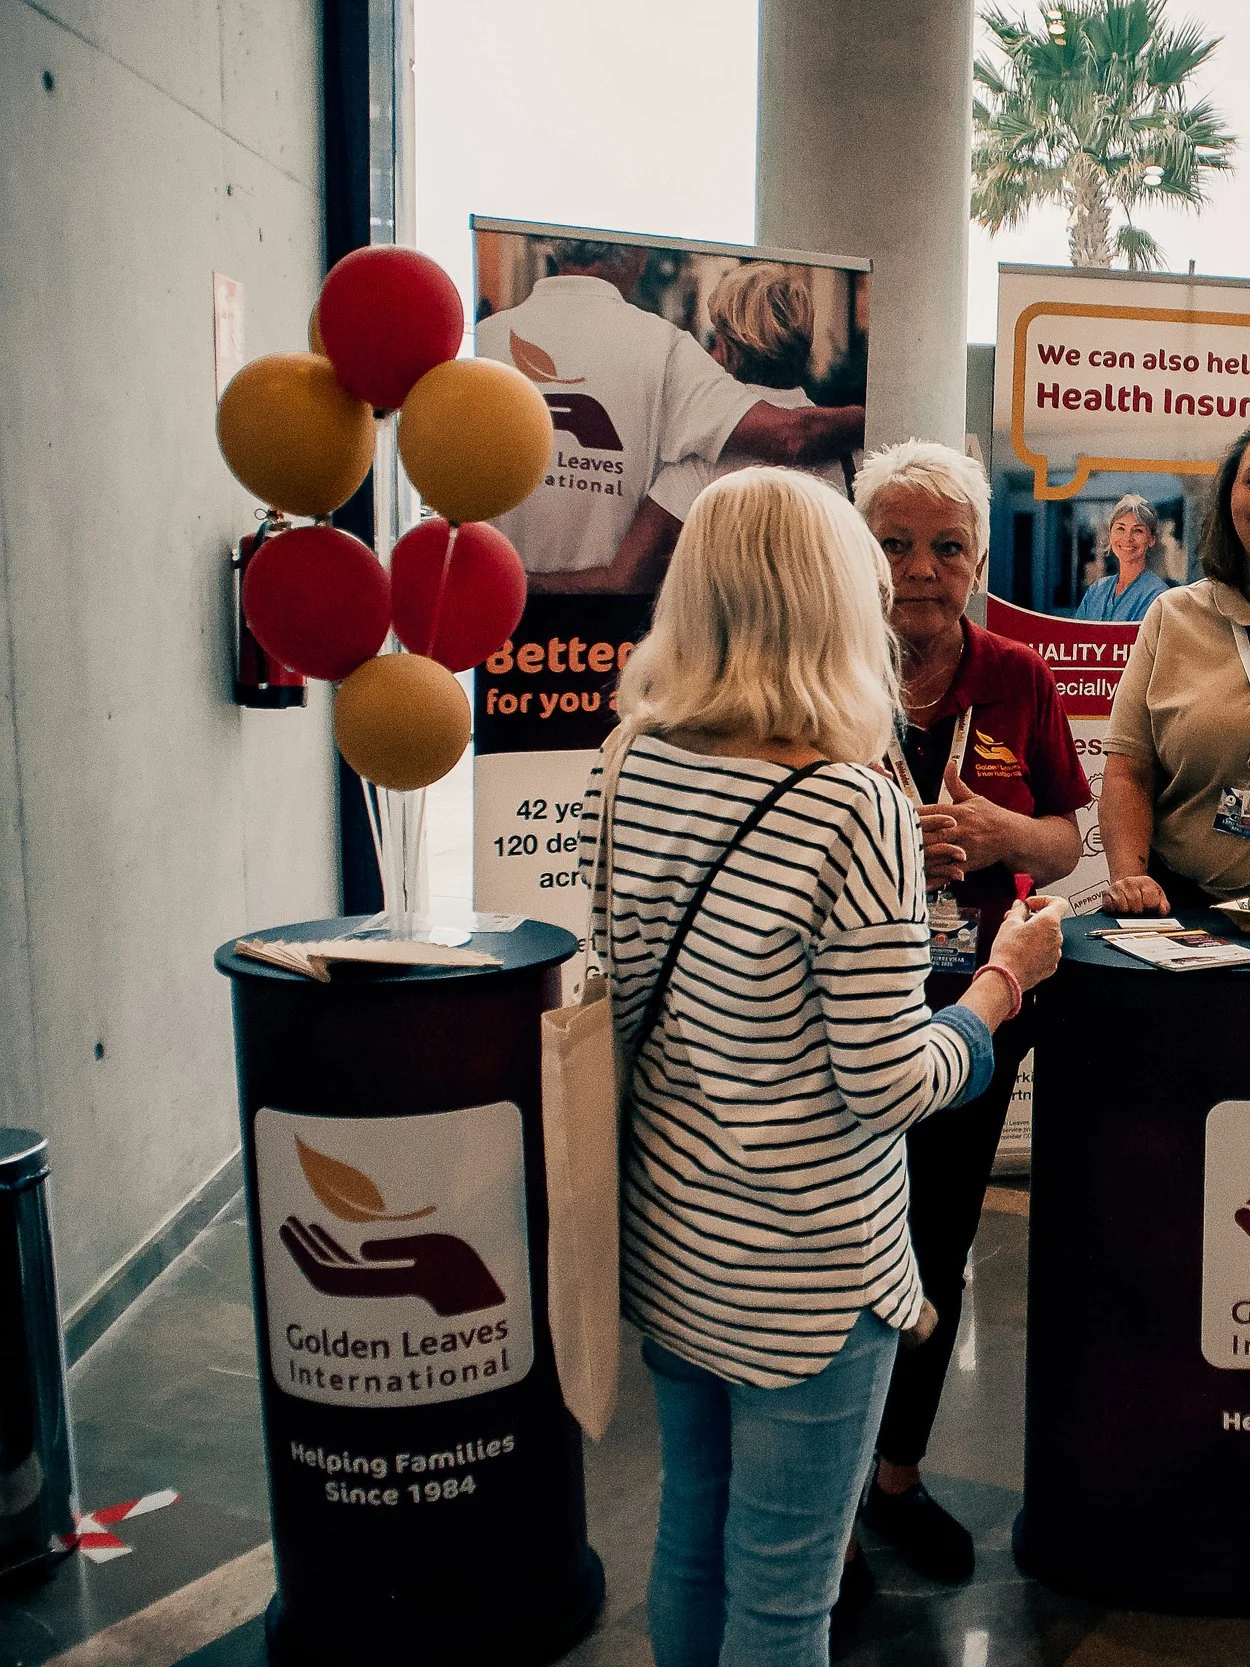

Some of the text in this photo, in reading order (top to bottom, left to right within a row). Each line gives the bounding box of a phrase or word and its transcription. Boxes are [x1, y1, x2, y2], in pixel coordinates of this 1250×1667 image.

[1037, 343, 1081, 366] We
[1088, 350, 1135, 369] can
[1142, 347, 1199, 373] also
[1036, 382, 1154, 414] Health
[558, 451, 624, 475] Leaves
[545, 474, 623, 497] ational
[1029, 643, 1107, 661] ALITY
[1056, 679, 1118, 700] ecially
[486, 688, 532, 714] for
[539, 692, 600, 719] you
[516, 799, 548, 821] 42
[494, 834, 538, 857] 120
[539, 871, 581, 889] acr
[1073, 892, 1102, 909] APPROV
[285, 1319, 509, 1360] Golden Leaves
[289, 1349, 510, 1393] International
[291, 1433, 515, 1479] Helping Families
[325, 1474, 477, 1507] Since 1984
